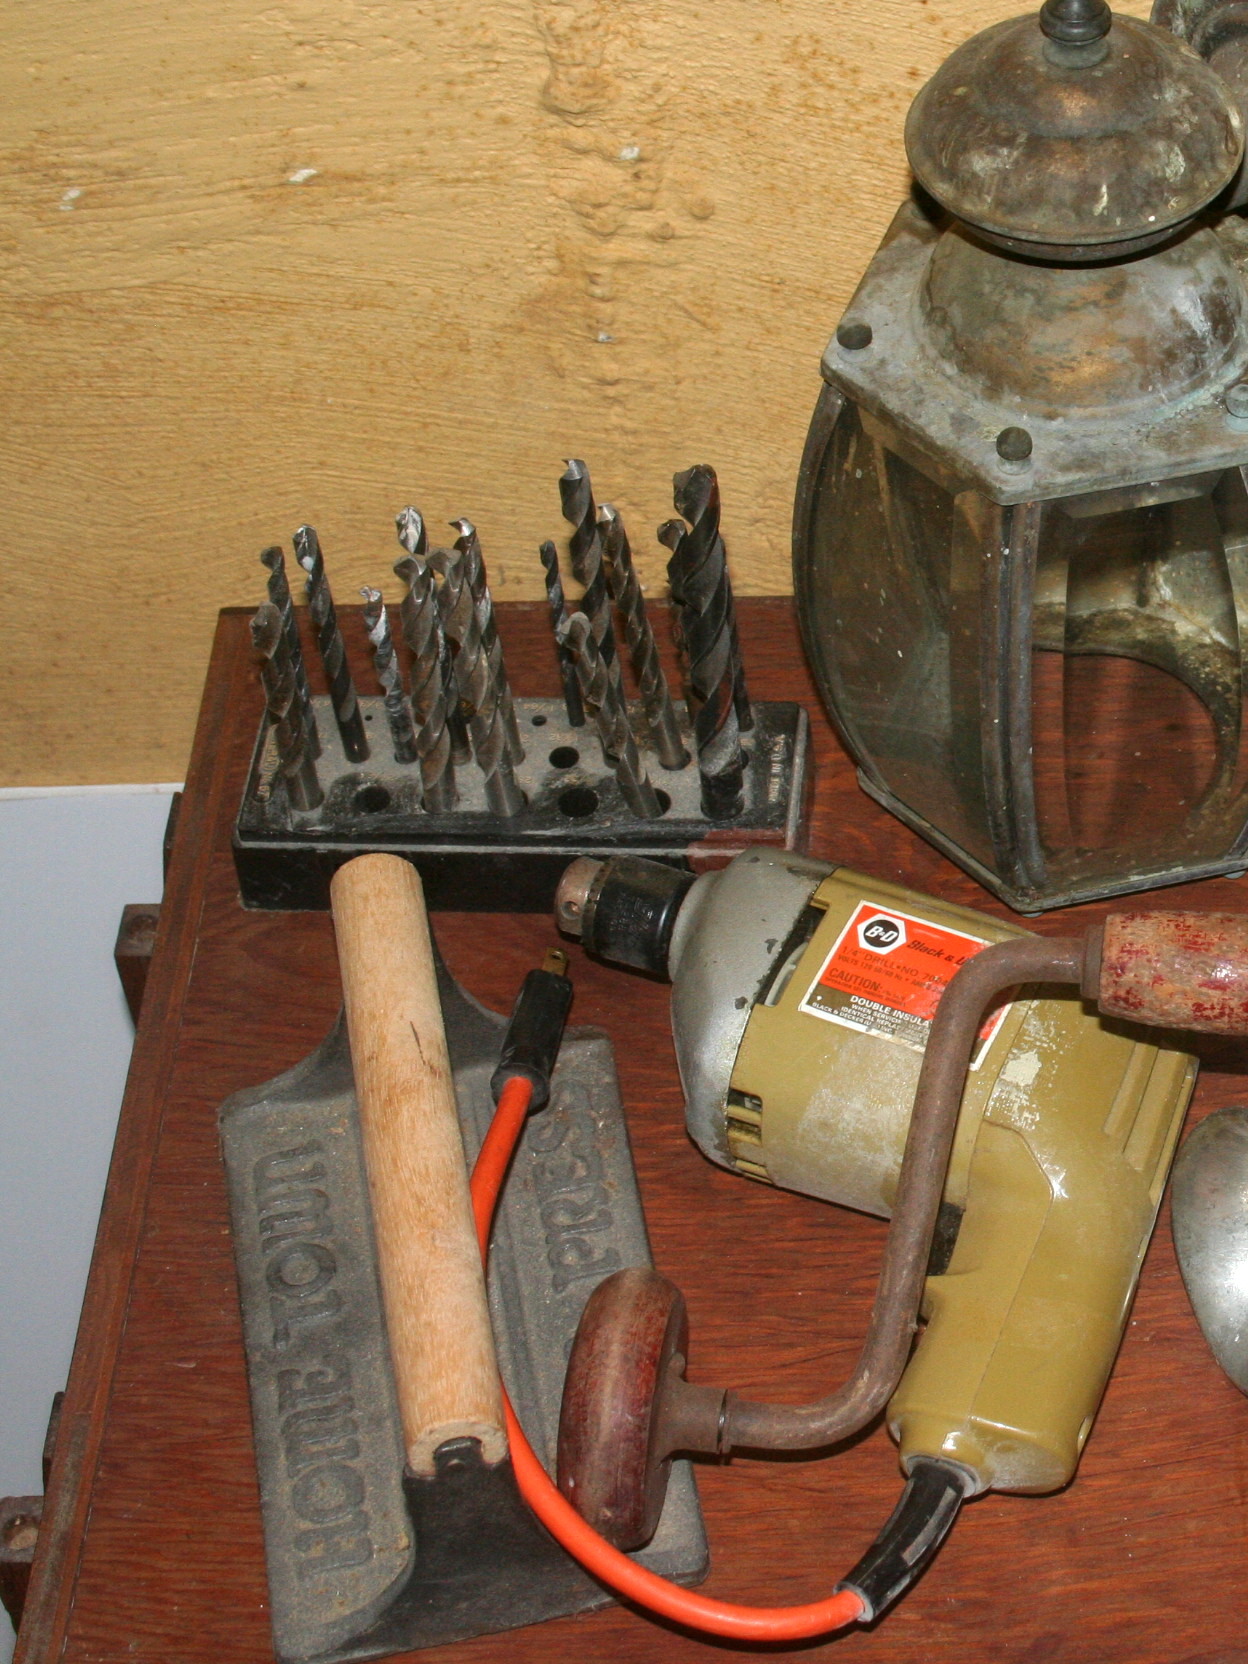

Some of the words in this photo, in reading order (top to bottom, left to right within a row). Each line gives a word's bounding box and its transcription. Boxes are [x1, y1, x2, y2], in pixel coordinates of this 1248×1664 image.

[865, 925, 898, 943] B&D
[906, 939, 943, 958] Black
[828, 967, 883, 991] CAUTION:
[812, 1002, 832, 1012] BLACK
[841, 1006, 875, 1021] IDENTICAL
[850, 995, 890, 1013] DOUBLE
[893, 1009, 933, 1027] INSULA
[279, 1353, 373, 1581] HOME
